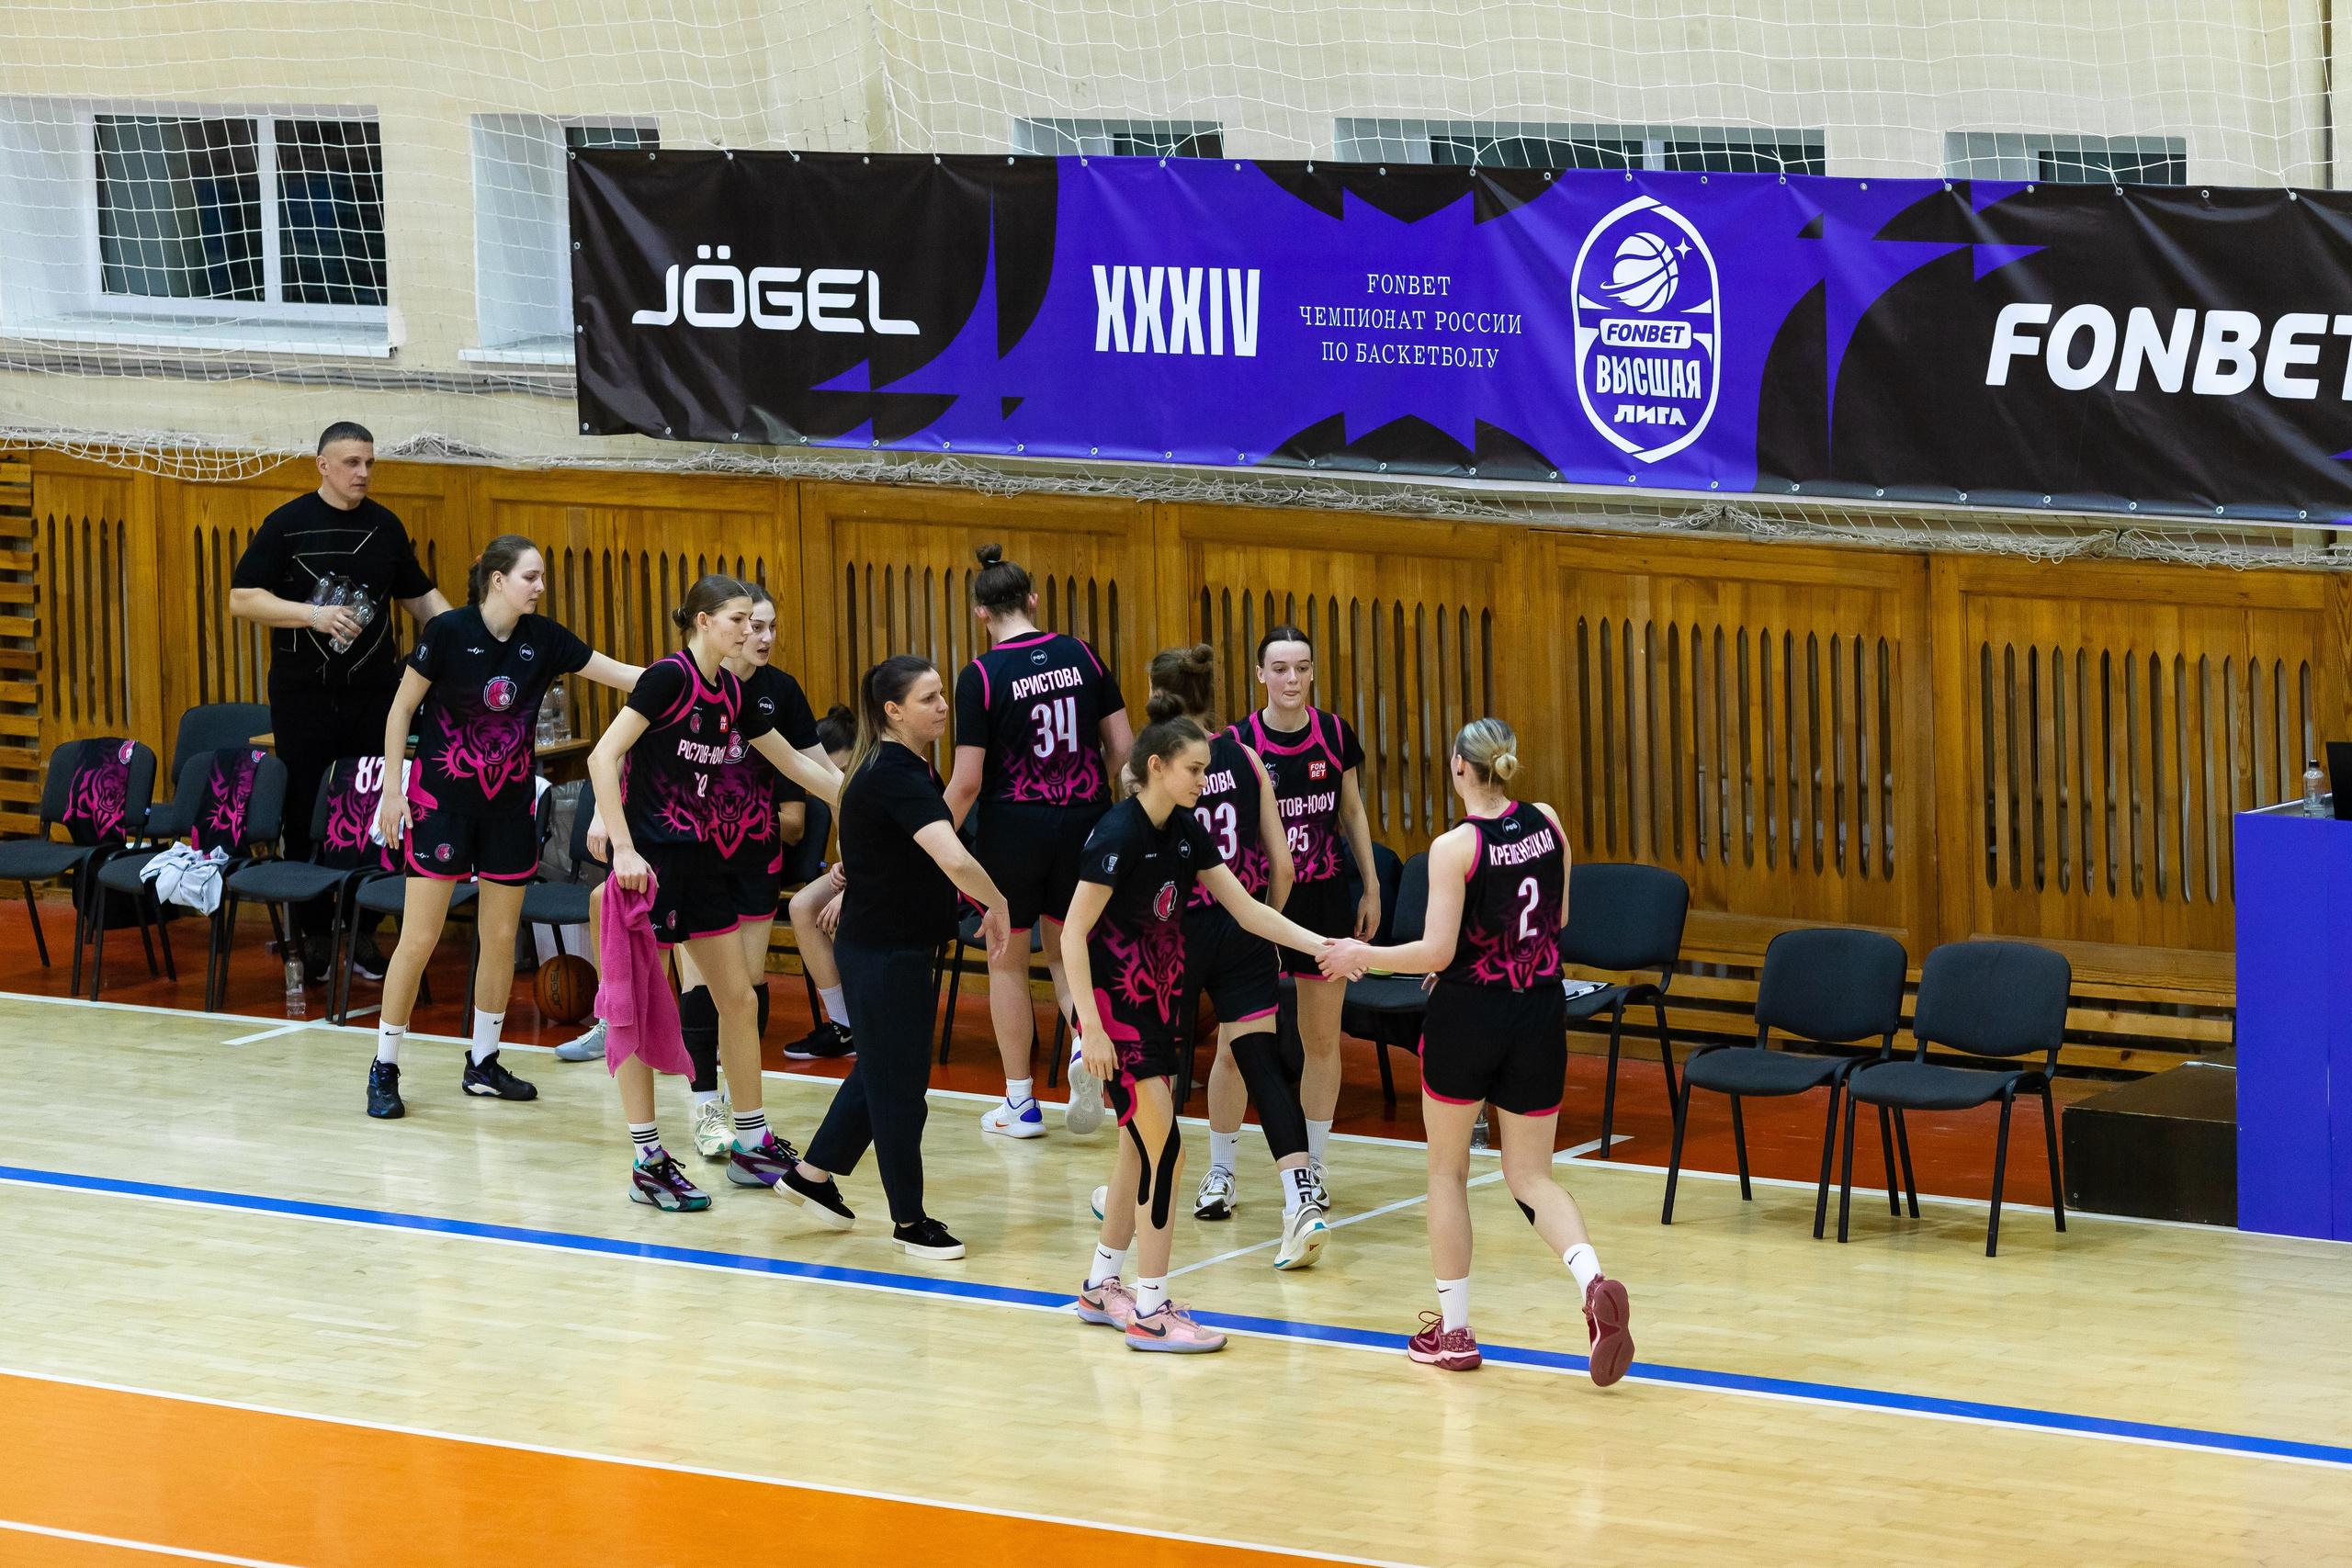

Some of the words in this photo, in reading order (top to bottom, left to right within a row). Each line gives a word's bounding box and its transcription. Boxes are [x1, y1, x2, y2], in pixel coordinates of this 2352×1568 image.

[631, 244, 920, 334] JÖGEL
[1366, 274, 1451, 296] FONBET
[1092, 265, 1260, 356] XXXIV
[1298, 306, 1426, 330] ЧЕМПИОНАТ
[1434, 310, 1522, 334] РОССИИ
[1607, 323, 1686, 344] FONBET
[1321, 341, 1348, 362] ПО
[1355, 343, 1499, 368] БАСКЕТБОЛУ
[1596, 355, 1702, 399] ВЫСШАЯ
[1613, 404, 1687, 425] ЛИГА
[1012, 666, 1083, 701] АРИСТОВА
[1030, 696, 1078, 758] 34
[1310, 762, 1326, 771] FON
[1311, 770, 1326, 778] BET
[1201, 770, 1237, 796] ВОВА
[1277, 791, 1336, 818] ТОВ-ЮФУ
[1287, 824, 1309, 852] 85
[1518, 876, 1539, 942] 2
